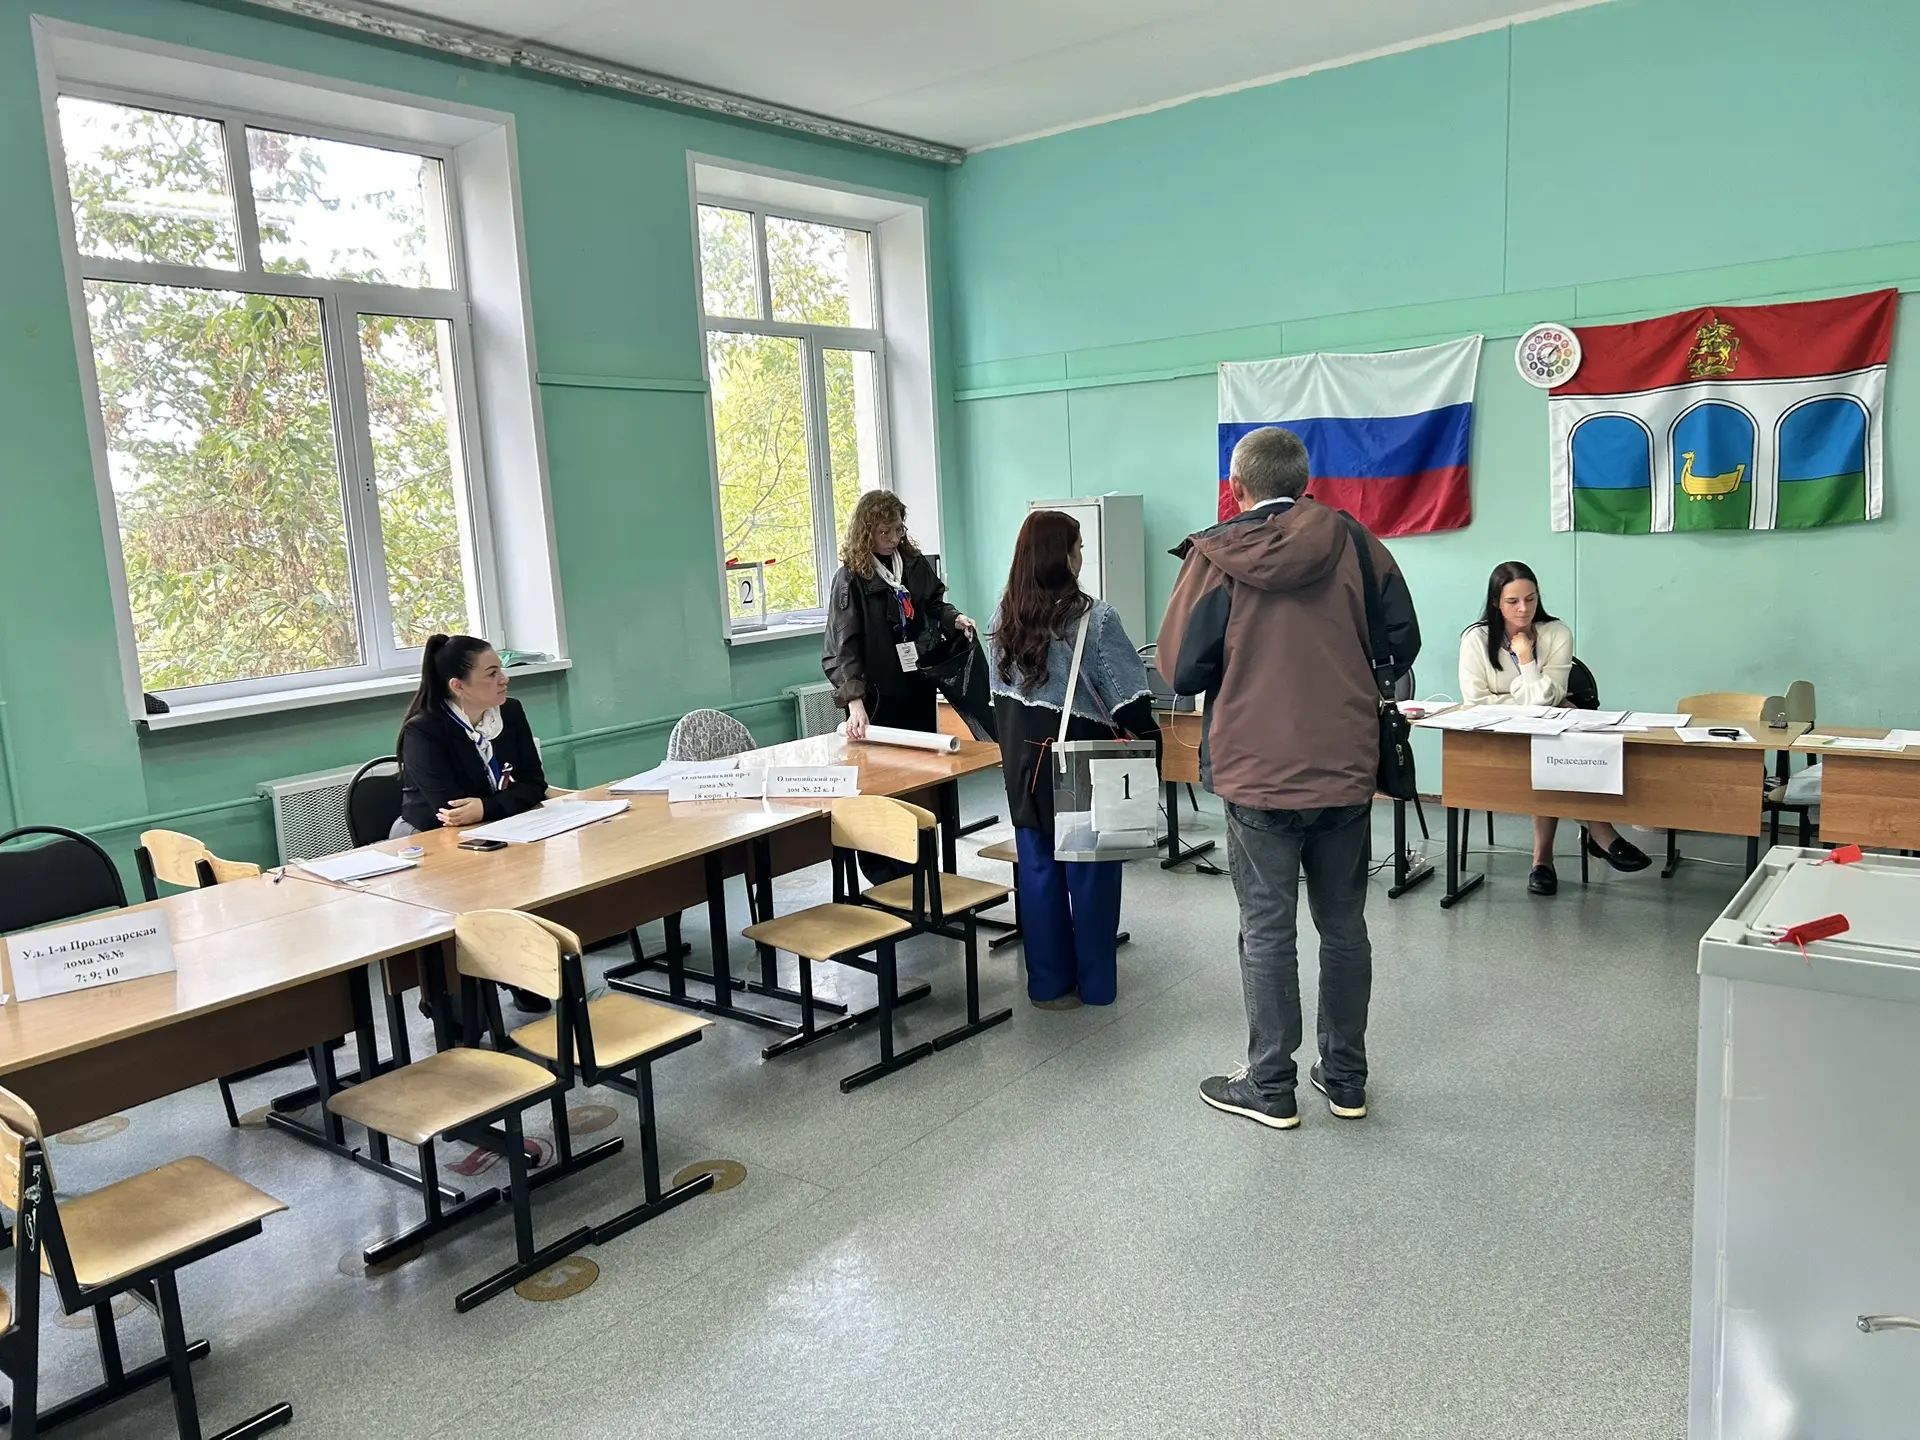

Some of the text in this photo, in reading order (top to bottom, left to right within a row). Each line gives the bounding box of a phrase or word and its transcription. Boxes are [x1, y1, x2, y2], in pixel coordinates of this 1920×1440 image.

[741, 580, 753, 604] 2
[1546, 756, 1608, 766] Председатель
[1121, 773, 1132, 800] 1
[22, 927, 157, 960] Ул. 1-я Пролетарская
[64, 949, 124, 970] дома №№
[75, 966, 119, 983] 7; 9; 10
